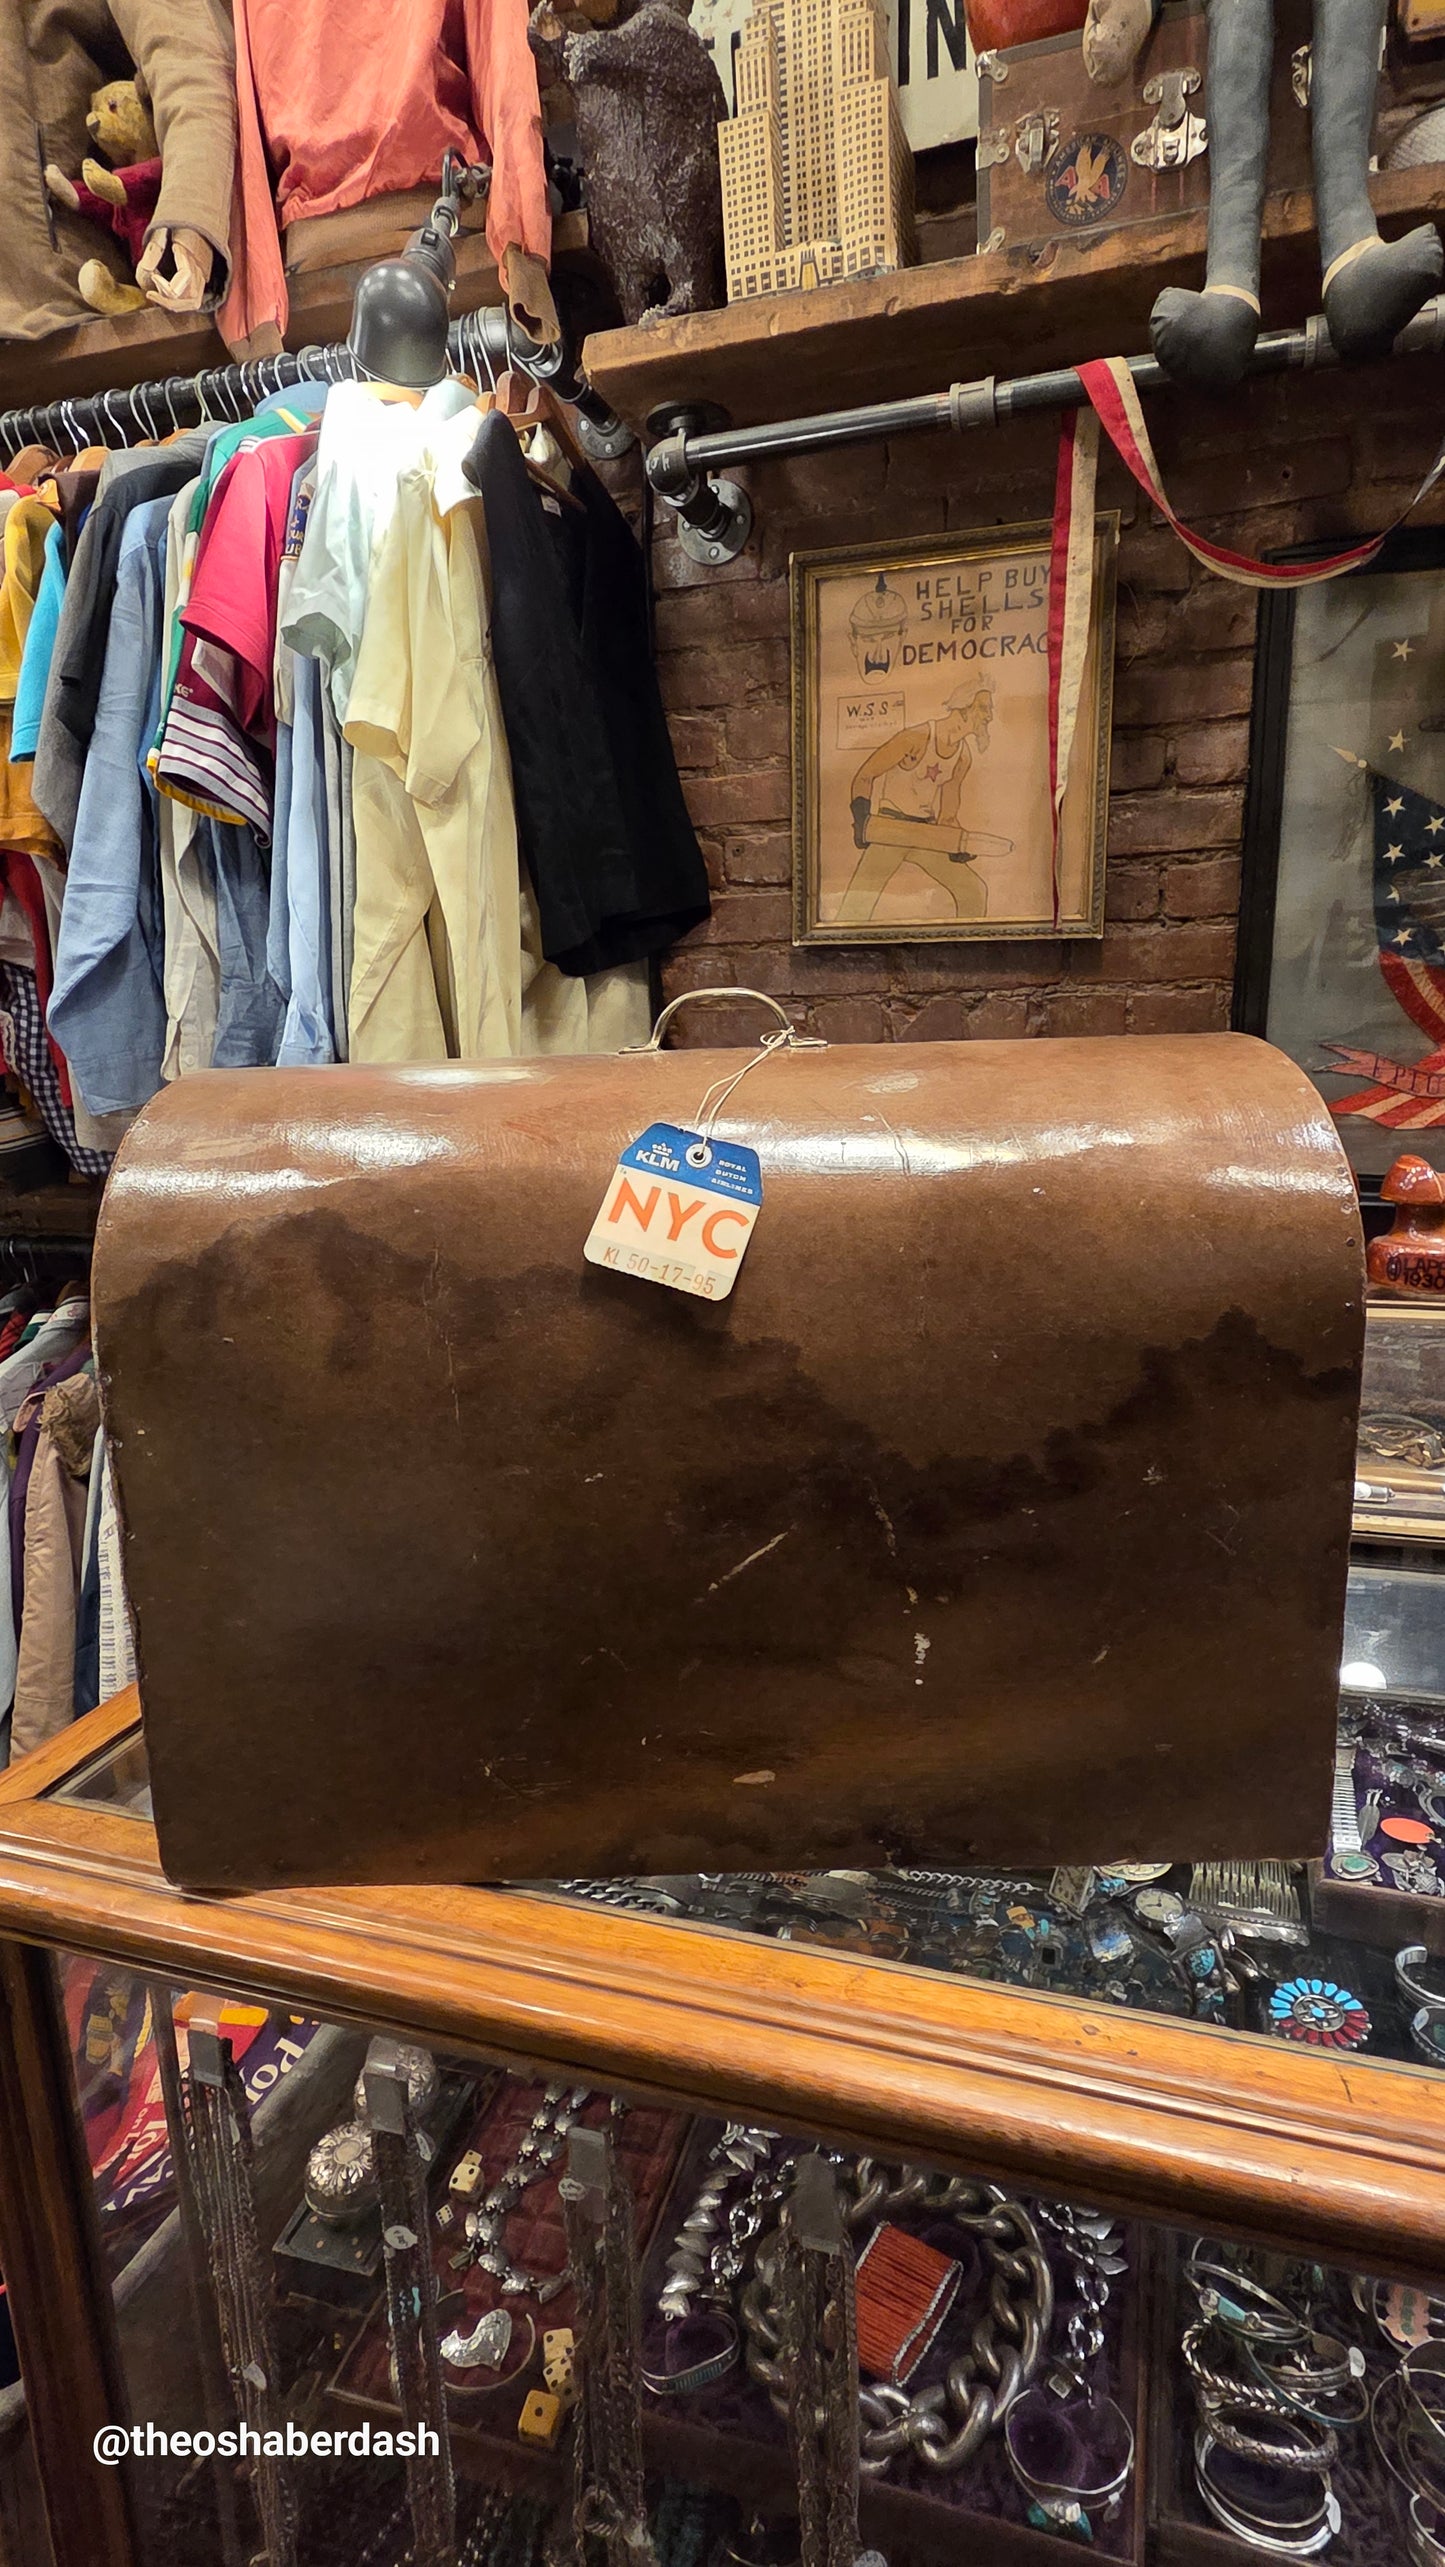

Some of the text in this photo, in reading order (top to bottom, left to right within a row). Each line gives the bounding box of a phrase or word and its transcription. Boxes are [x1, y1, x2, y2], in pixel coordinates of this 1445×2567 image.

[916, 564, 1052, 600] HELP BUY
[921, 588, 1045, 622] SHELLS
[951, 615, 994, 634] FOR
[635, 1149, 681, 1172] KLM
[718, 1159, 747, 1173] ROYAL
[711, 1177, 753, 1195] AIRLINES
[715, 1169, 747, 1182] DUTCH
[607, 1177, 750, 1259] NYC
[603, 1246, 717, 1295] KL 50-17-95
